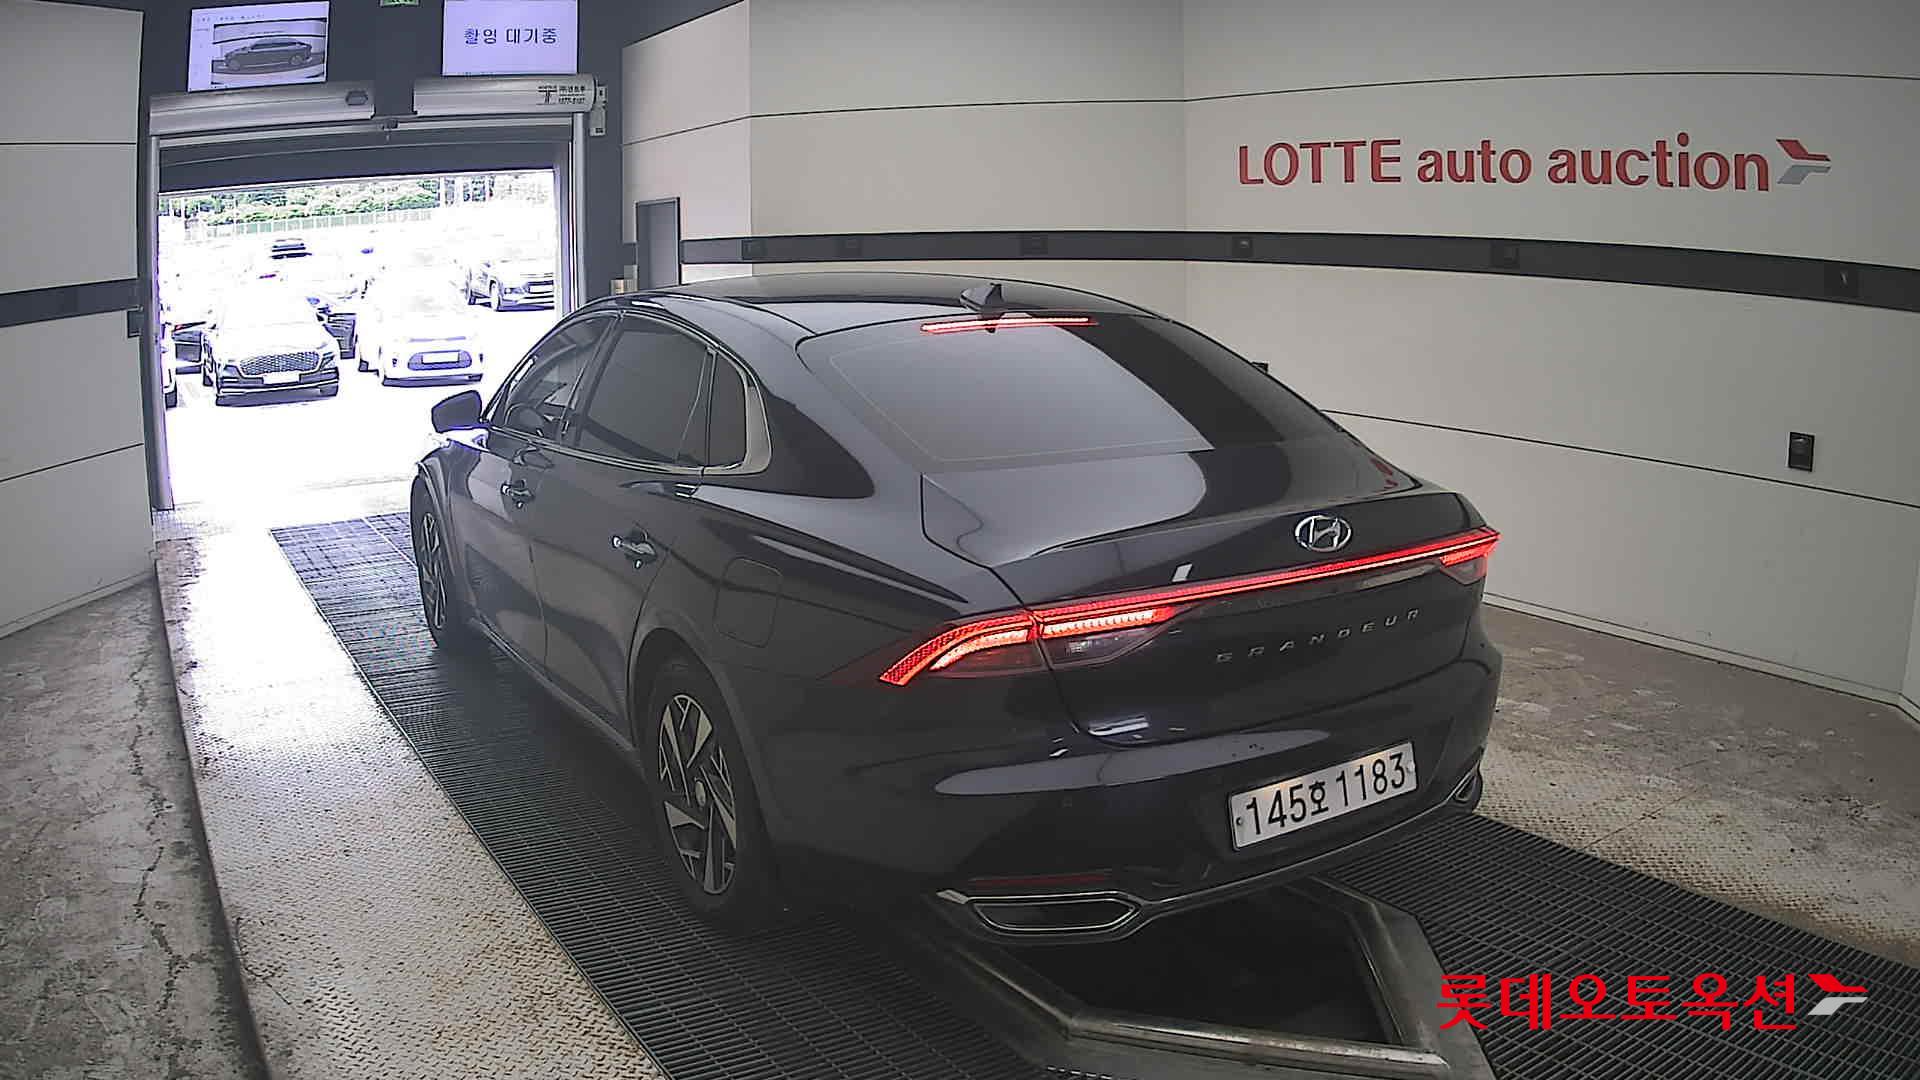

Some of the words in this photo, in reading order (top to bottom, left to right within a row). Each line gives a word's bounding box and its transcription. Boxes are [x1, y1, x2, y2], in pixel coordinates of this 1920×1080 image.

[506, 28, 558, 44] 대기중
[1239, 138, 1401, 186] LOTTE
[1416, 139, 1532, 184] auto
[1547, 131, 1770, 192] auction
[1216, 608, 1419, 663] GRANDEUR
